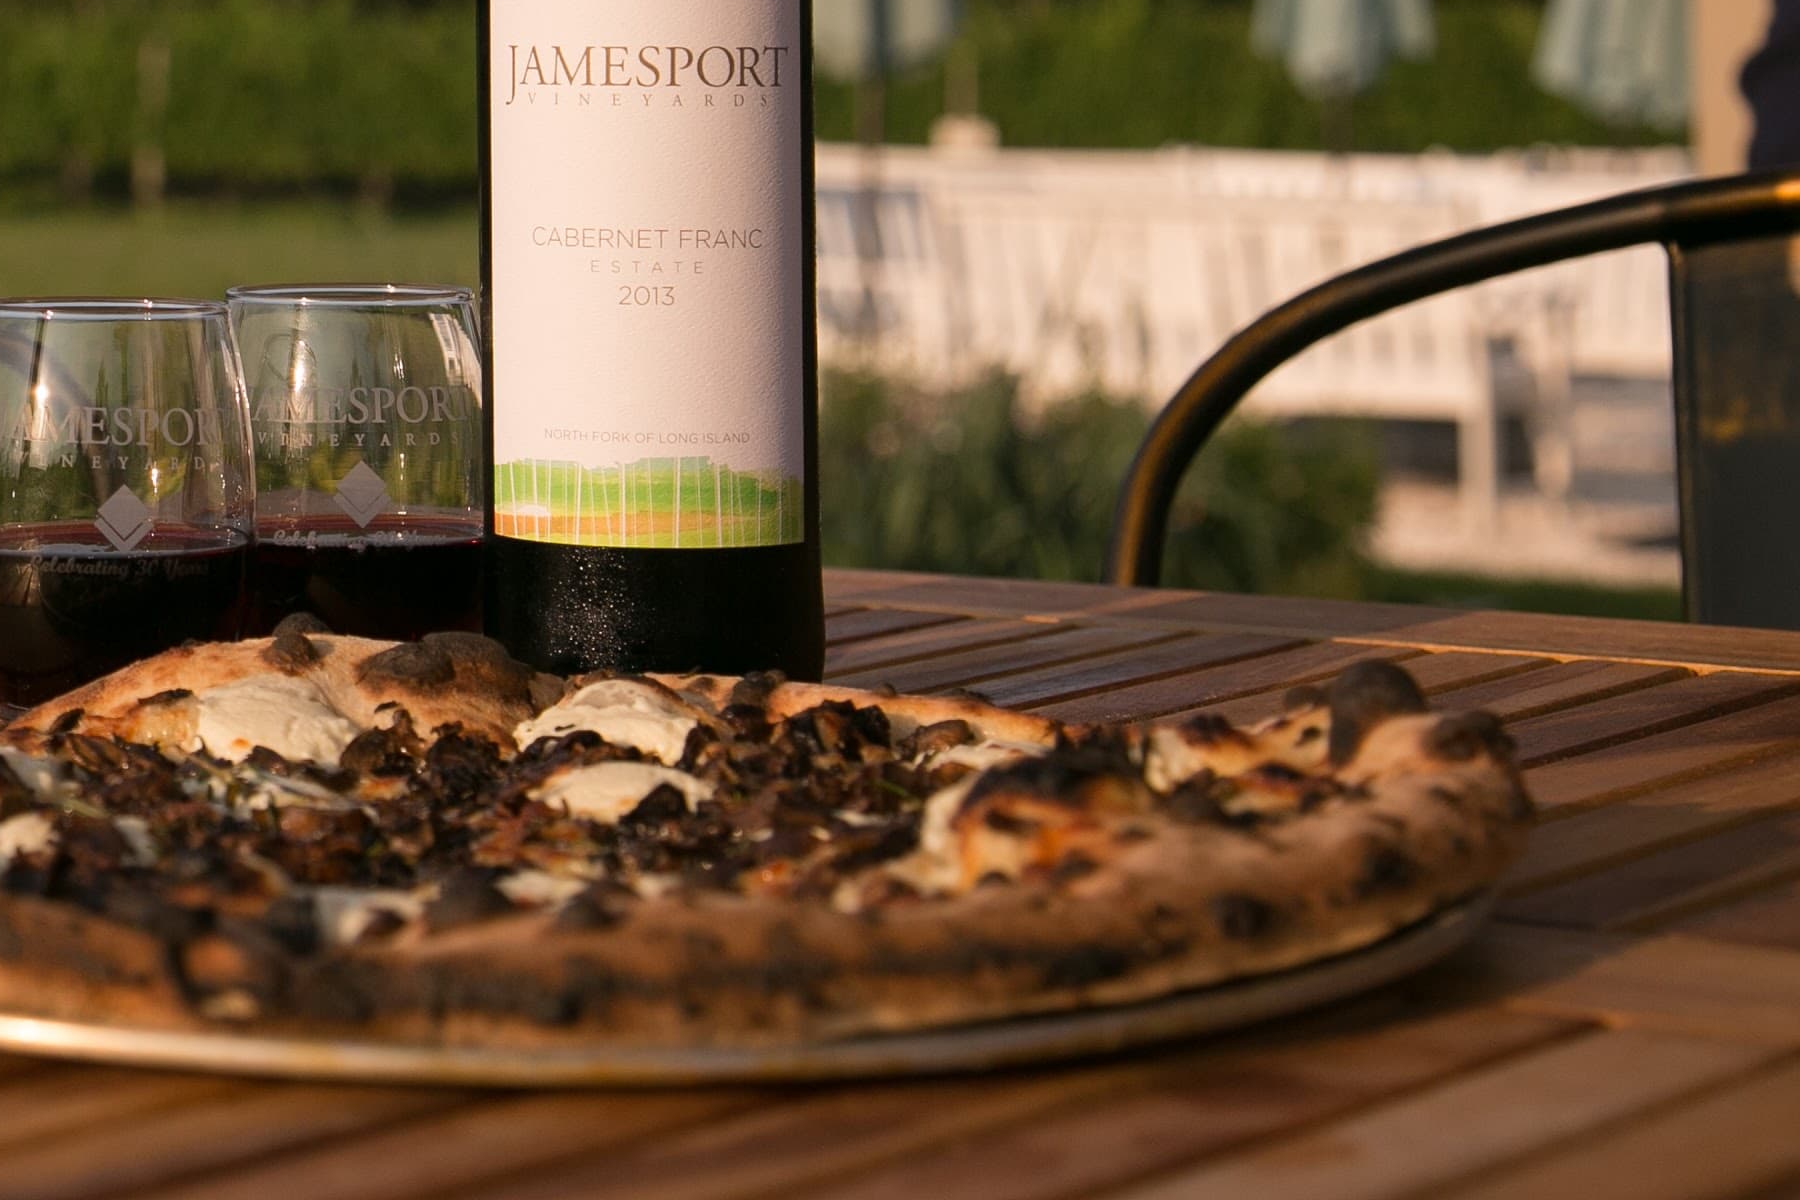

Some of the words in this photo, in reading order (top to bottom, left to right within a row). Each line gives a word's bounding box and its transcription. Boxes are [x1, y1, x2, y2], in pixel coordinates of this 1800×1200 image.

[505, 44, 789, 106] JAMESPORT
[527, 92, 769, 107] VINEYARDS
[531, 226, 669, 250] CABERNET
[678, 228, 764, 250] FRANC
[590, 259, 705, 274] ESTATE
[617, 285, 676, 307] 2013
[543, 428, 588, 442] NORTH
[591, 430, 631, 444] FORK
[634, 431, 654, 445] OF
[658, 432, 699, 445] LONG
[701, 432, 751, 445] ISLAND
